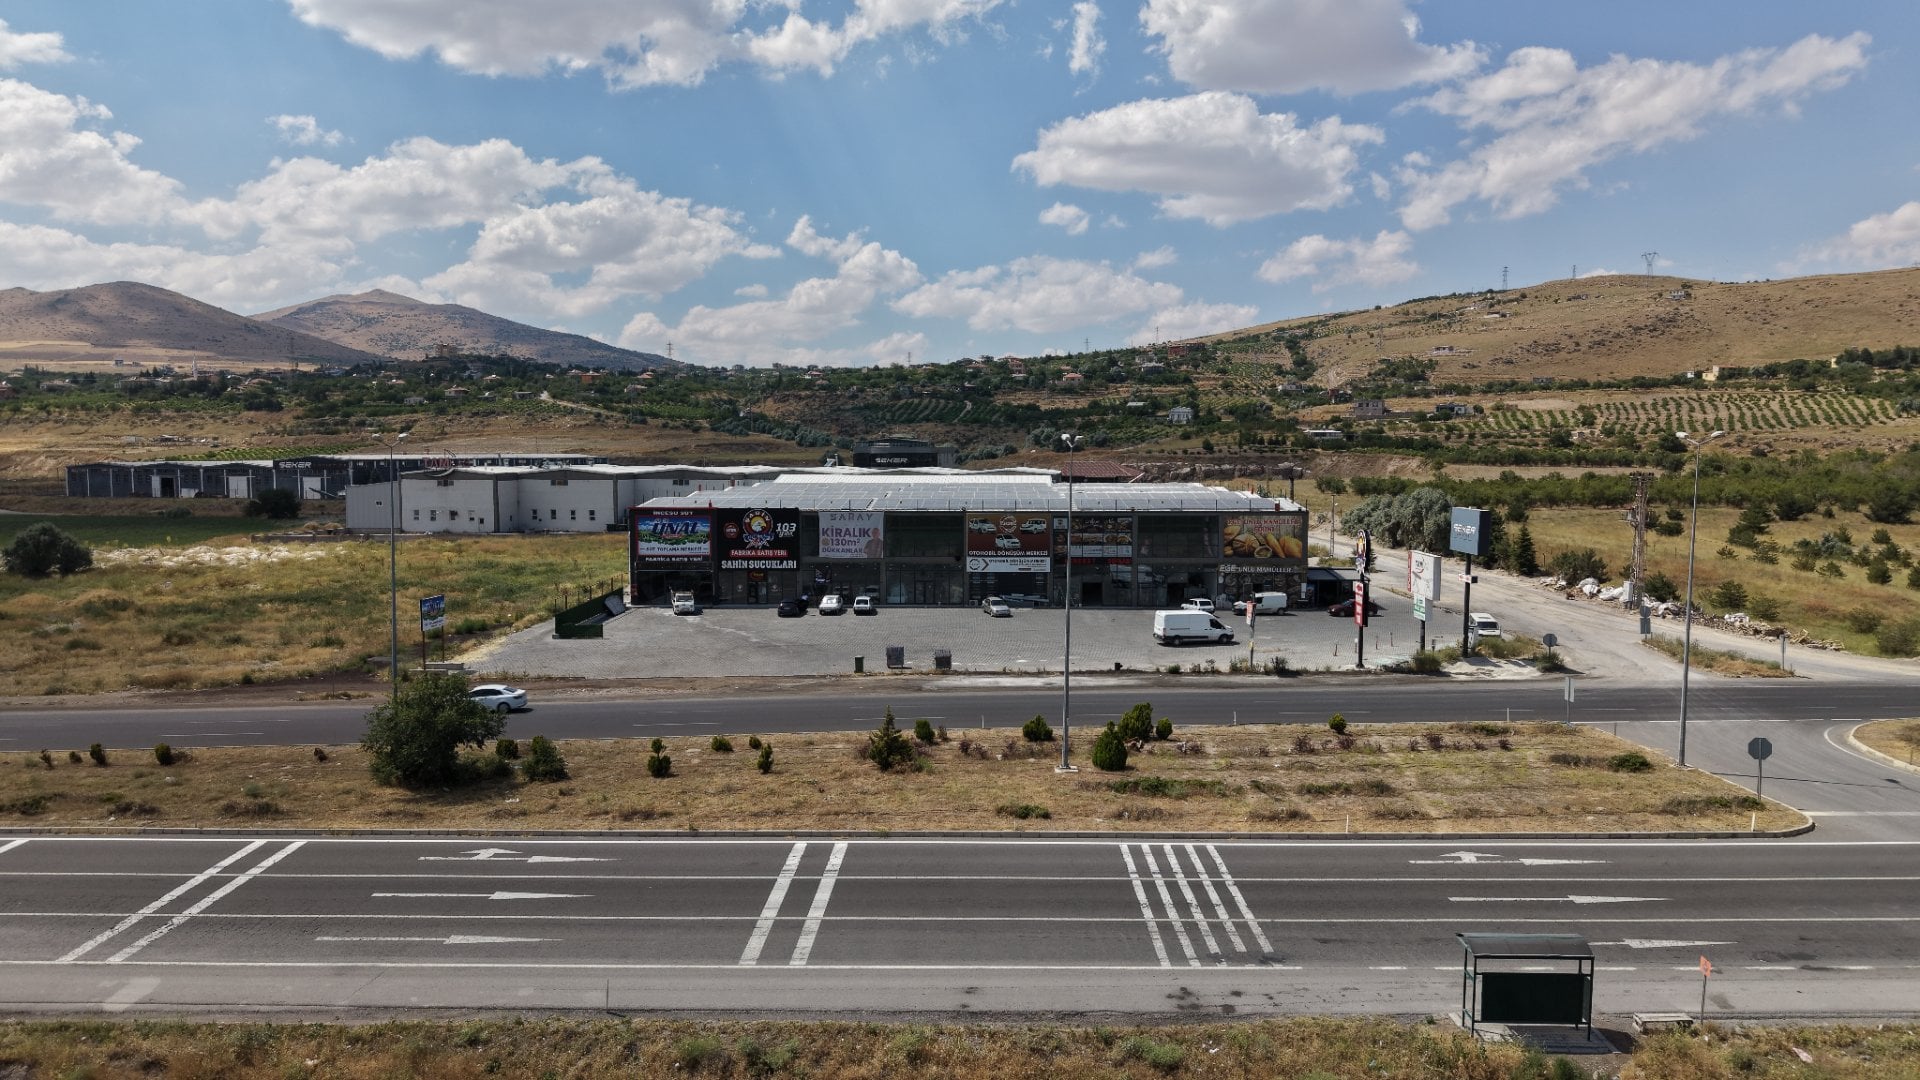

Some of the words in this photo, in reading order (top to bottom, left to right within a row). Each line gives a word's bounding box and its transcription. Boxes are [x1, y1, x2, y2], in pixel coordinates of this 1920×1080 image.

[830, 513, 873, 521] SARAY
[776, 523, 797, 532] 103
[822, 525, 871, 537] KİRALIK
[748, 560, 797, 569] SUCUKLARI
